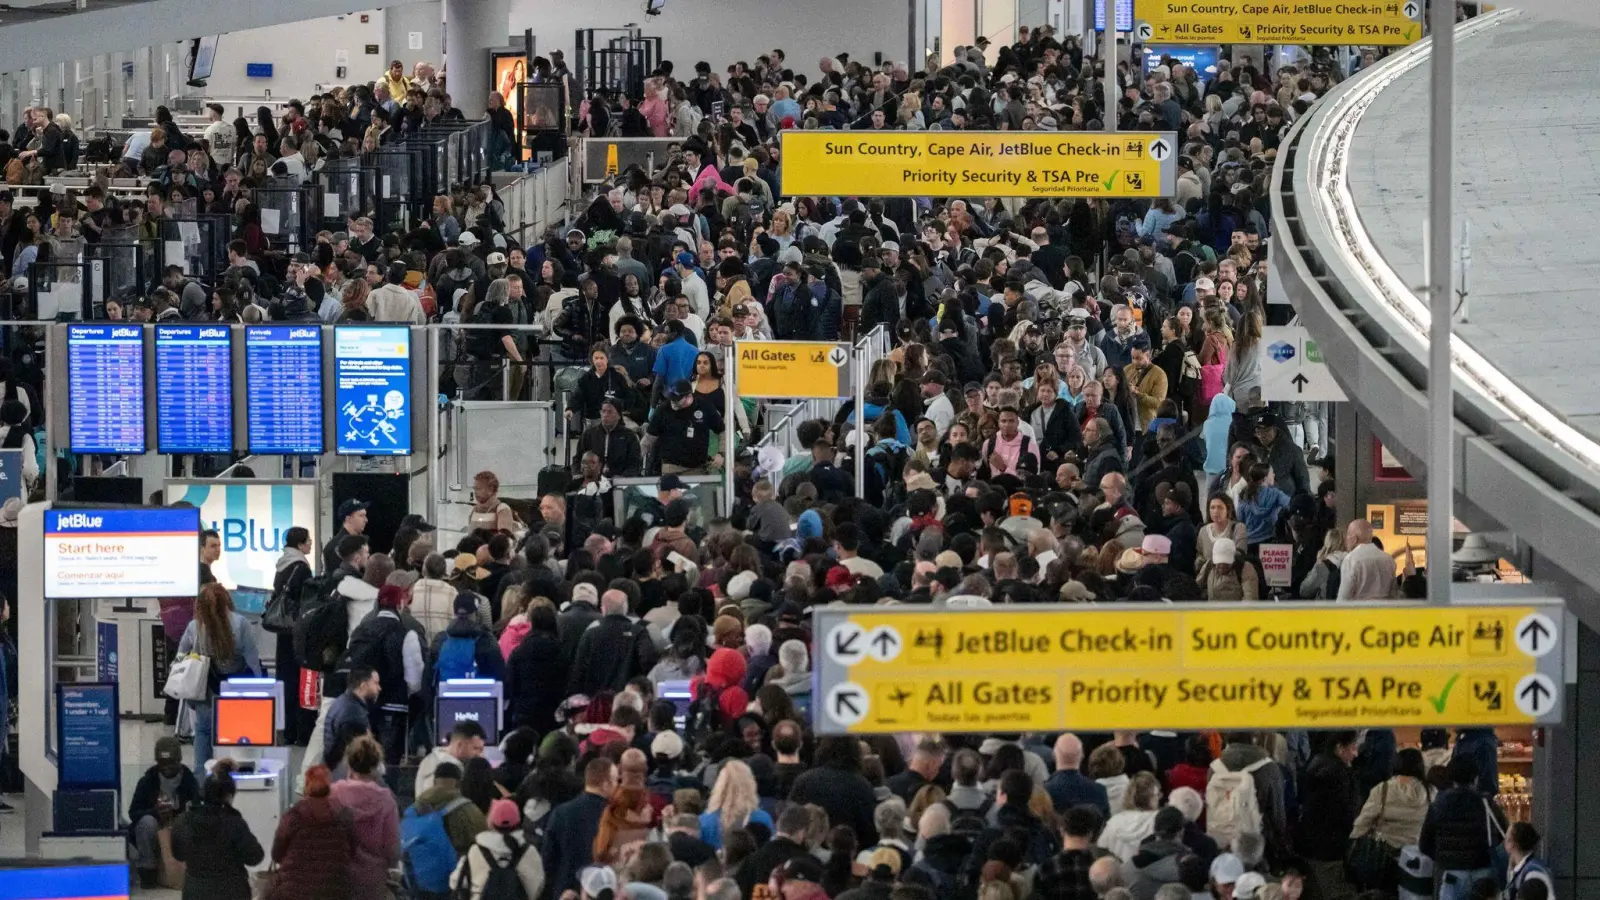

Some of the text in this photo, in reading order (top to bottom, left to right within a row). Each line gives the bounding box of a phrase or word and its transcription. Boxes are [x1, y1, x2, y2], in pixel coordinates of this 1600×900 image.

[1168, 4, 1382, 16] Sun Country, Cape Air, JetBlue Check-in
[1175, 24, 1223, 34] All Gates
[1256, 25, 1400, 35] Priority Security & TSA Pre
[825, 142, 1120, 158] Sun Country, Cape Air, JetBlue Check-in
[903, 170, 1099, 185] Priority Security & TSA Pre
[112, 328, 138, 338] jetBlue
[199, 328, 226, 339] jetBlue
[289, 329, 317, 339] jetBlue
[742, 350, 796, 361] All Gates
[57, 514, 103, 531] jetBlue
[58, 543, 124, 554] Start here
[106, 571, 124, 580] aquí
[955, 626, 1172, 654] JetBlue Check-in
[1192, 624, 1464, 656] Sun Country, Cape Air
[926, 682, 1052, 705] All Gates
[1070, 677, 1421, 708] Priority Security & TSA Pre
[926, 712, 960, 722] Todas
[964, 712, 981, 722] las
[1296, 706, 1421, 720] Seguridad Prioritaria
